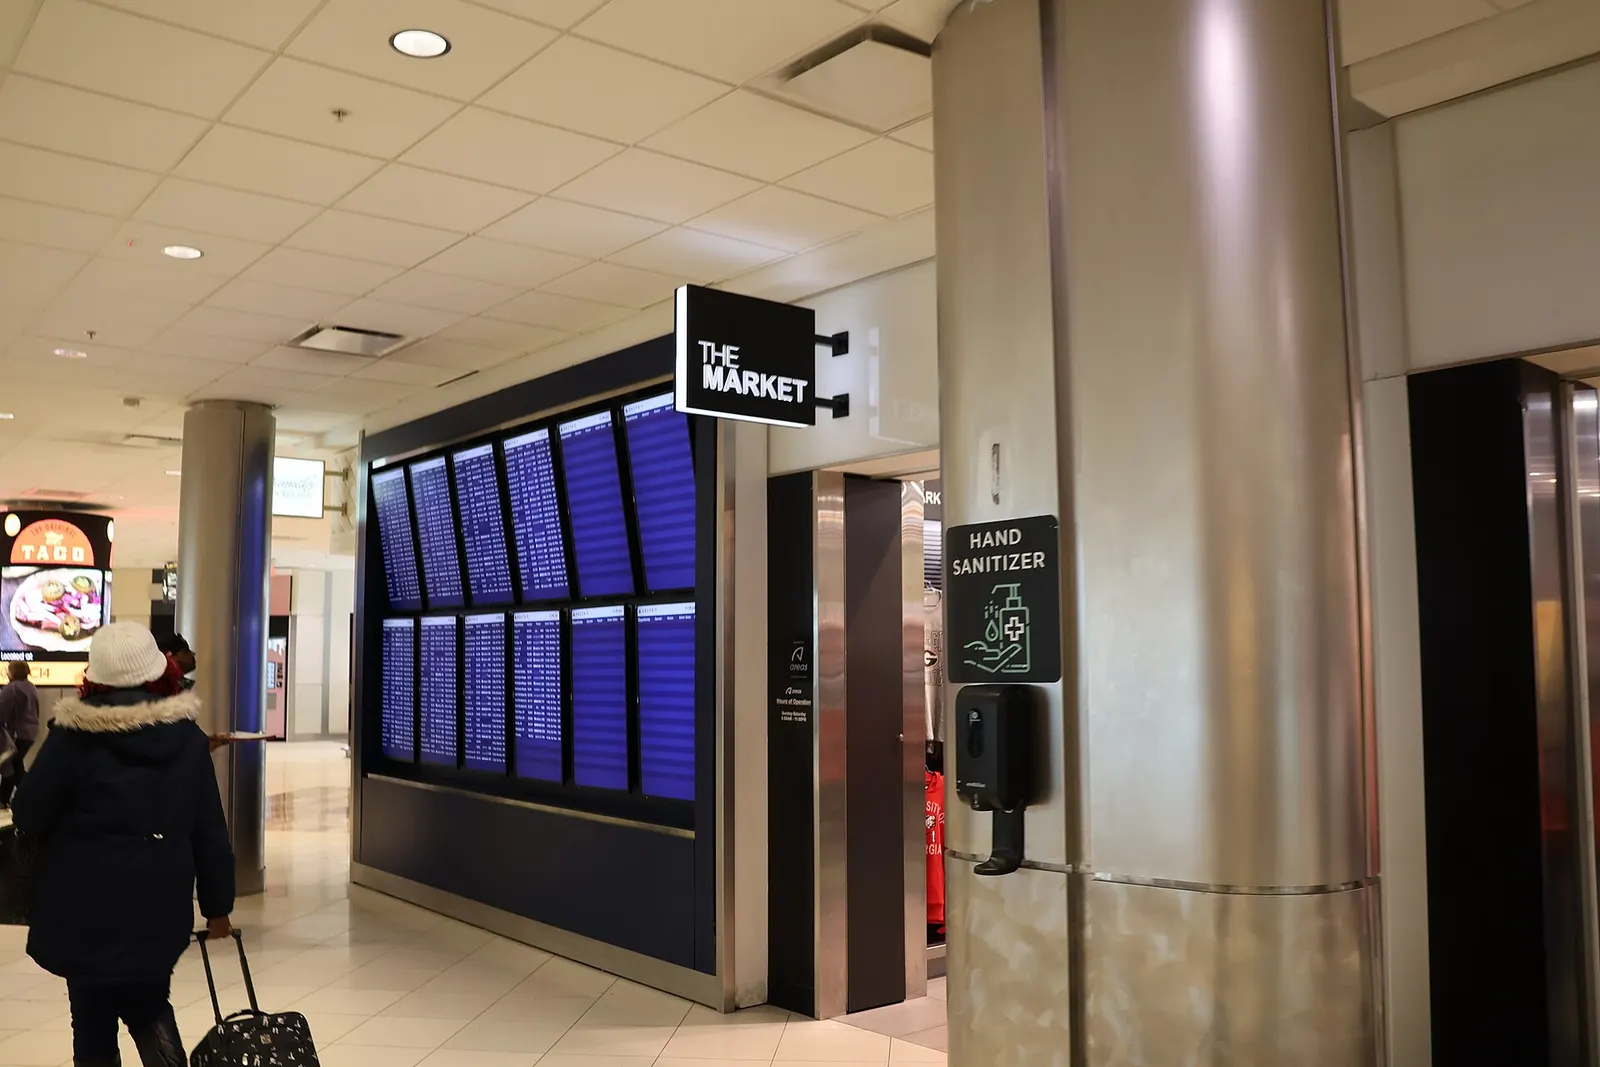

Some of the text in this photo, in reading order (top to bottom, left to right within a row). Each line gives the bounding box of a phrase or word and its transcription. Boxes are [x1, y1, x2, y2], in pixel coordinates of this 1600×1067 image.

[698, 340, 740, 369] THE
[702, 364, 808, 403] MARKET
[924, 490, 942, 505] RK
[969, 528, 1022, 549] HAND
[952, 551, 1046, 576] SANITIZER
